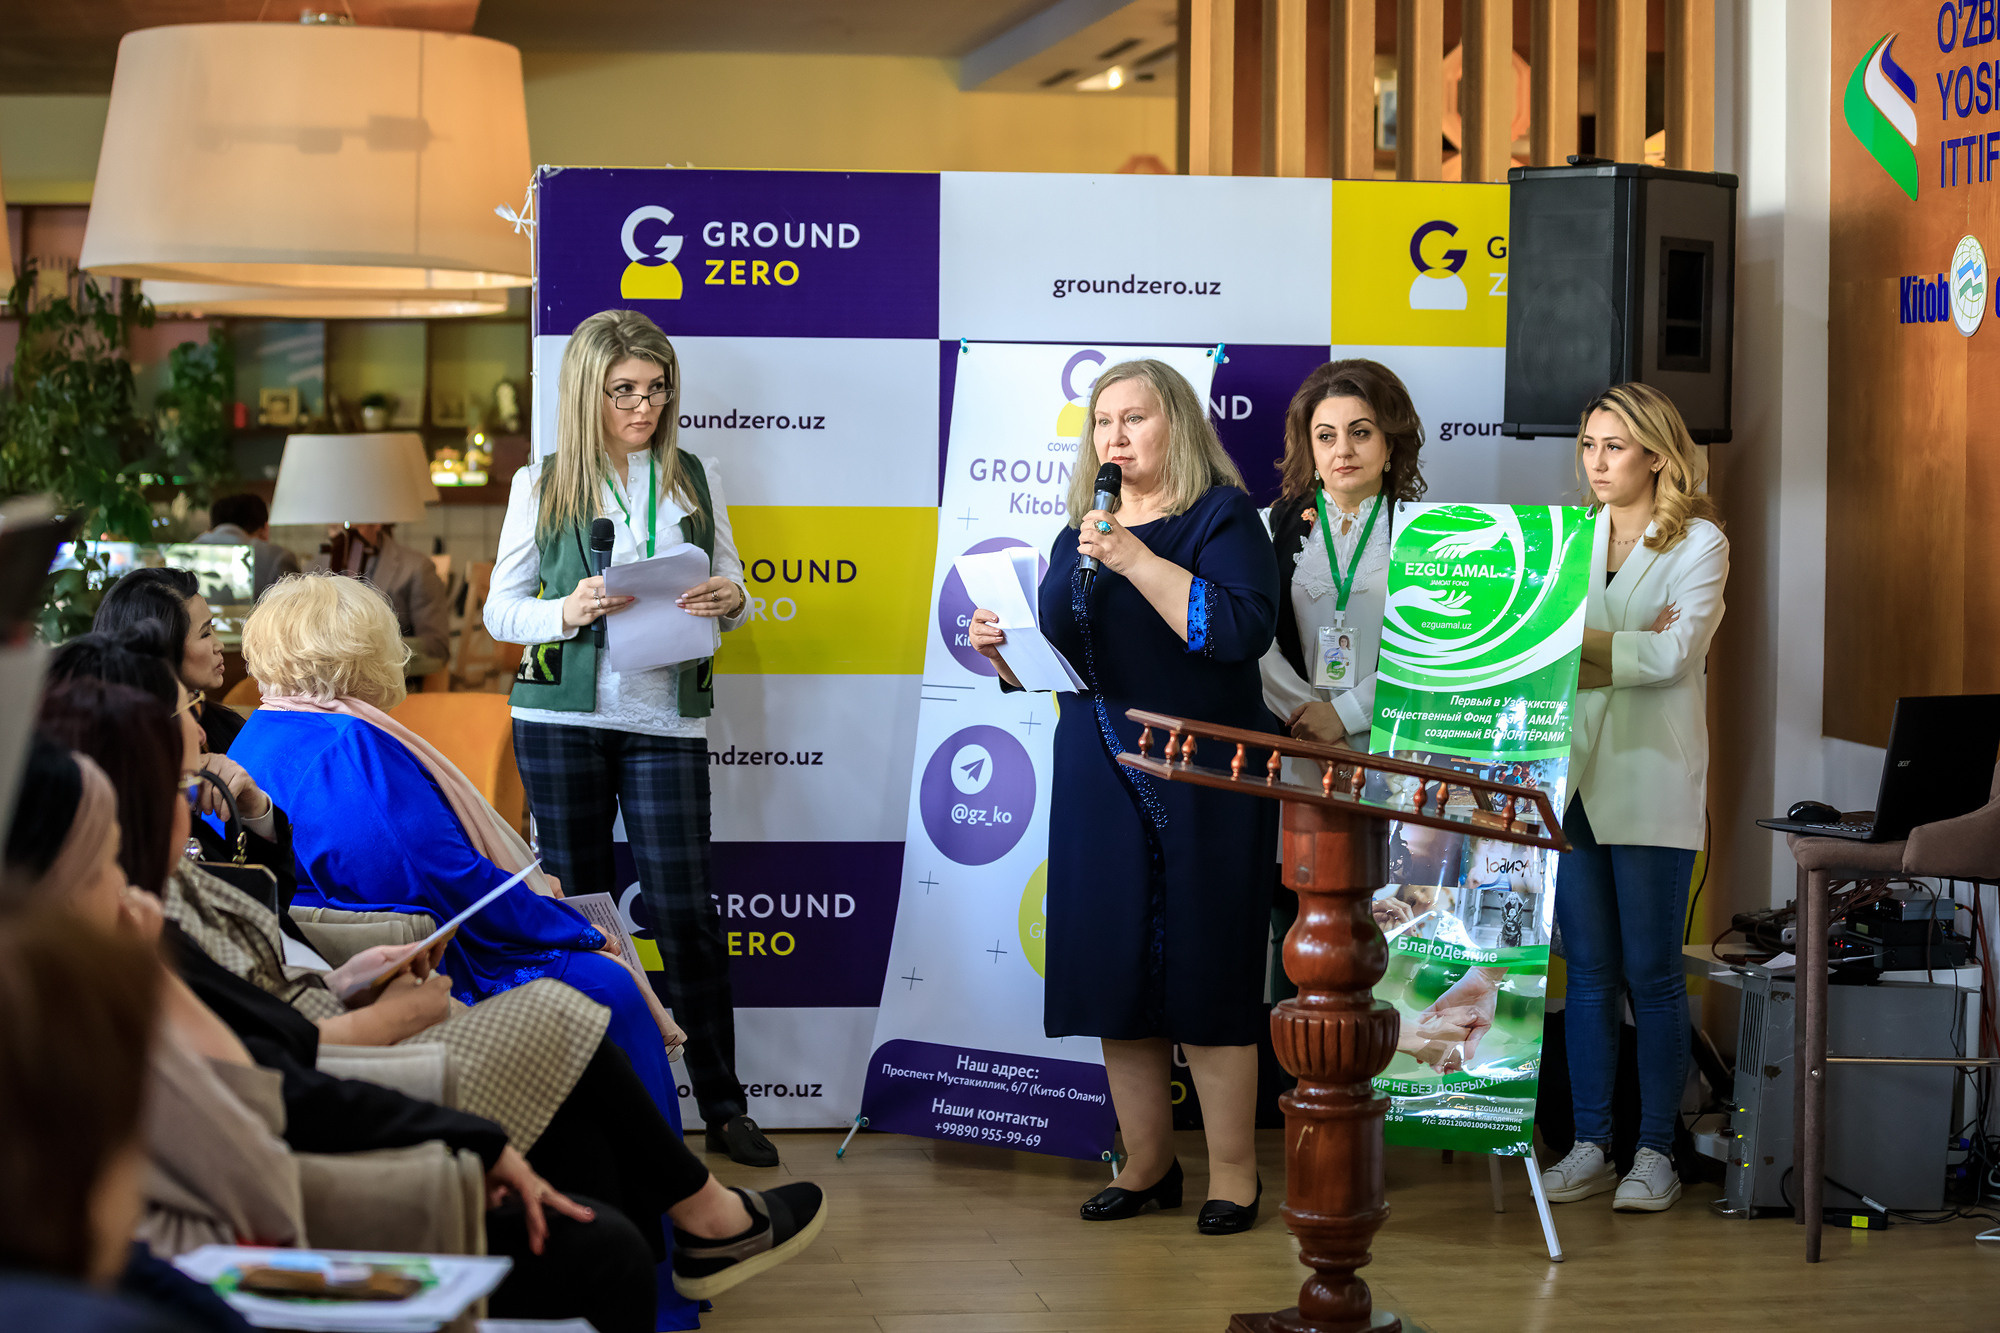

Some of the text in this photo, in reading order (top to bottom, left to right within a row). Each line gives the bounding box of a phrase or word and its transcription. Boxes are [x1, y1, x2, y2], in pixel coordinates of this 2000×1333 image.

[702, 221, 860, 249] GROUND
[704, 259, 800, 286] ZERO
[1052, 273, 1221, 298] groundzero.uz
[1900, 273, 1950, 324] Kitob
[678, 408, 825, 430] oundzero.uz
[1210, 395, 1253, 420] ND
[1439, 421, 1503, 441] groun
[1047, 442, 1079, 452] COWO
[969, 458, 1077, 485] GROUN
[1009, 492, 1067, 516] Kitob
[741, 559, 857, 583] OUND
[1405, 563, 1498, 578] EZGU AMAL
[750, 597, 797, 621] RO
[1421, 621, 1472, 630] ezguamal.uz
[1450, 695, 1492, 708] Первый
[1493, 699, 1501, 707] в
[1381, 708, 1462, 721] Общественный
[1463, 712, 1492, 724] Фонд
[1424, 728, 1482, 739] созданный
[708, 744, 823, 765] ndzero.uz
[951, 803, 1012, 827] @gz_ko
[727, 931, 795, 956] ERO
[956, 1054, 1040, 1080] Наш адрес:
[882, 1063, 1106, 1106] Проспект Мустакиллик, 6/7 (Китоб Олами)
[1371, 1077, 1390, 1089] ИР
[1392, 1082, 1408, 1092] НЕ
[1410, 1083, 1433, 1094] БЕЗ
[1436, 1078, 1487, 1094] ДОБРЫХ
[931, 1098, 1049, 1128] Наши контакты
[935, 1122, 1041, 1147] +99890 955-99-69
